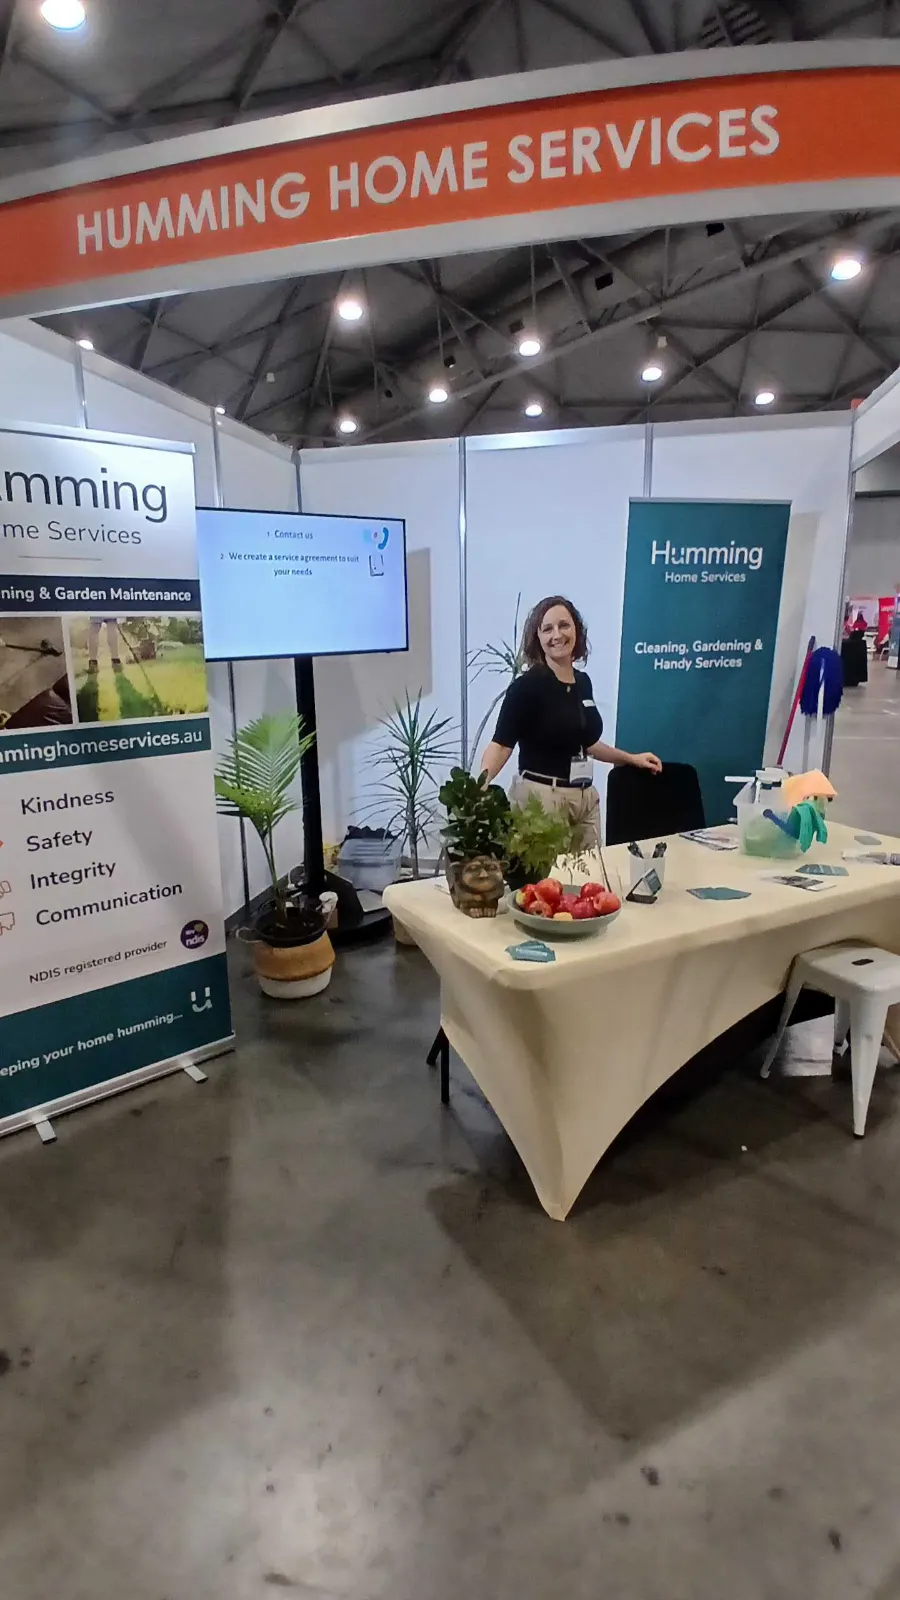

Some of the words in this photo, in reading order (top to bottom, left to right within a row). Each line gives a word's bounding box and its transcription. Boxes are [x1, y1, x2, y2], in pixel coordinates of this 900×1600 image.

[77, 172, 310, 255] HUMMING
[329, 141, 488, 211] HOME
[507, 104, 780, 184] SERVICES
[0, 467, 168, 523] mming
[47, 520, 142, 545] Services
[274, 529, 303, 539] Contact
[228, 552, 242, 560] We
[243, 553, 267, 561] create
[274, 553, 299, 561] service
[300, 554, 338, 563] agreement
[347, 555, 359, 563] suit
[651, 540, 763, 570] Humming
[273, 569, 290, 577] your
[291, 568, 313, 576] needs
[665, 571, 698, 583] Home
[701, 571, 746, 583] Services
[39, 586, 51, 600] &
[54, 586, 107, 600] Garden
[110, 587, 192, 602] Maintenance
[634, 641, 689, 655] Cleaning,
[693, 639, 752, 654] Gardening
[754, 638, 763, 650] &
[654, 658, 692, 671] Handy
[695, 656, 742, 669] Services
[0, 730, 203, 763] minghomeservices.au
[21, 791, 115, 815] Kindness
[26, 830, 93, 852] Safety
[30, 862, 117, 890] Integrity
[36, 883, 183, 926] Communication
[29, 967, 61, 984] NDIS
[64, 952, 122, 974] registered
[124, 940, 167, 961] provider
[43, 1045, 74, 1065] your
[77, 1032, 114, 1052] home
